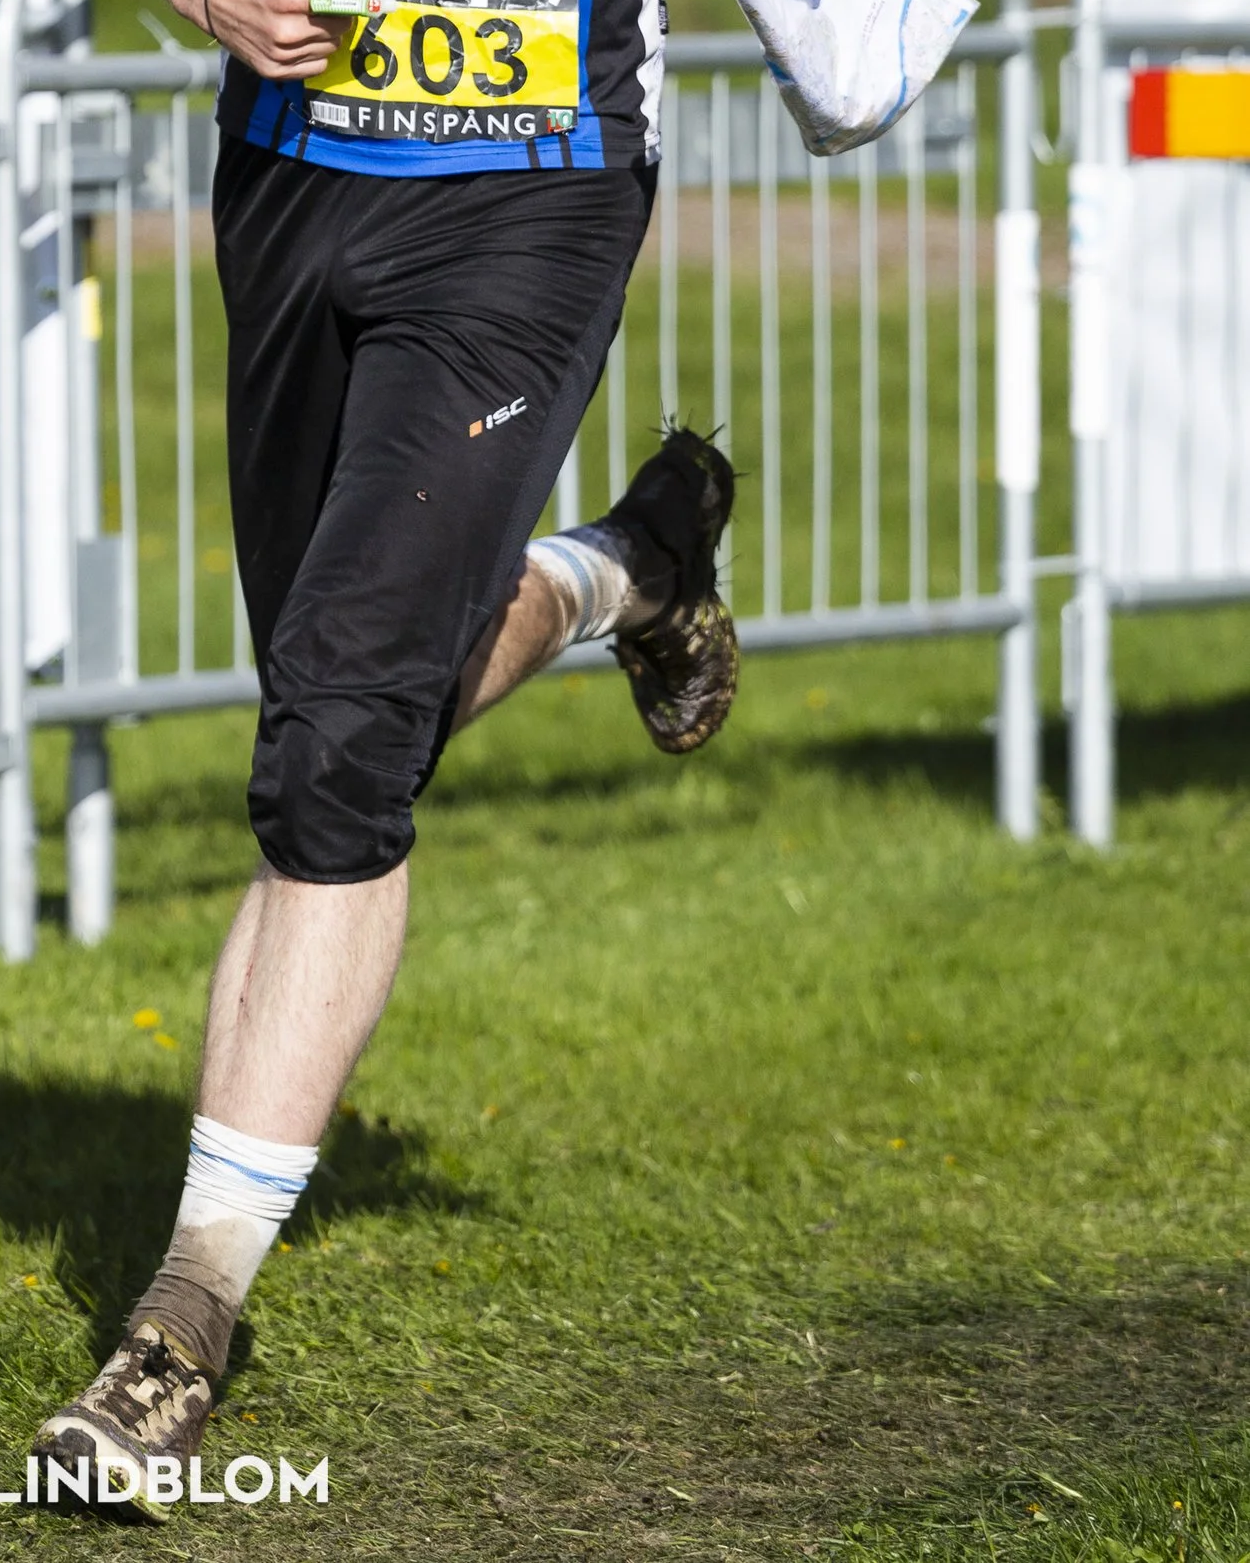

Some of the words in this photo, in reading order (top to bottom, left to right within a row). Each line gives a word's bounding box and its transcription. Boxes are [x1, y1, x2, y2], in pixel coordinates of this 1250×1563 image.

[350, 13, 528, 98] 603
[358, 107, 536, 135] FINSPÅNG
[485, 396, 528, 430] ISC
